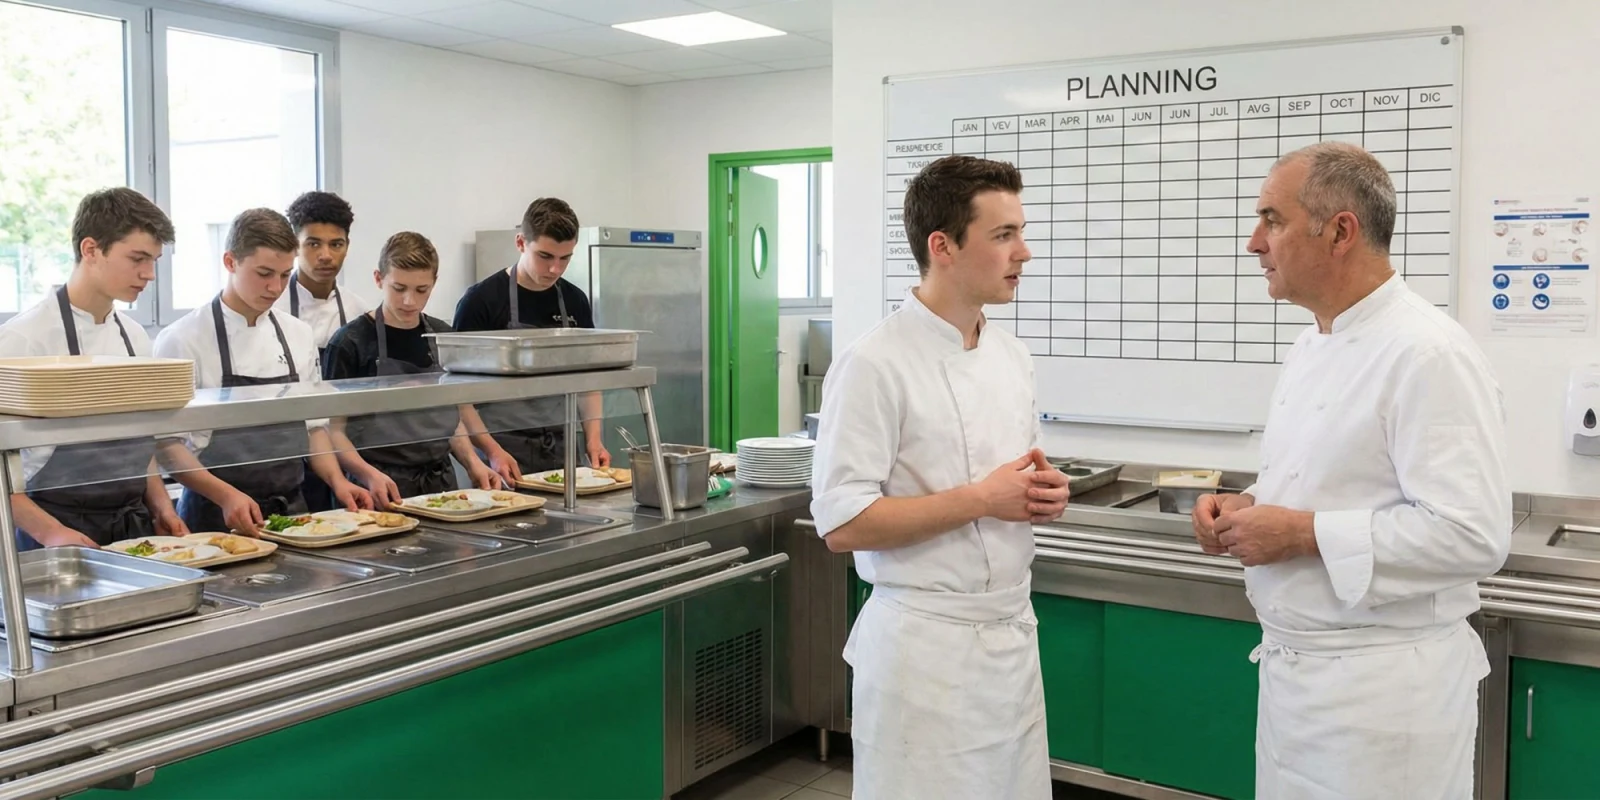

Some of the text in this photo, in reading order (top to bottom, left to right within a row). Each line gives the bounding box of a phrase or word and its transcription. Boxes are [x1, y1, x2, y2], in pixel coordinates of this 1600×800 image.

[1067, 66, 1218, 101] PLANNING
[960, 92, 1441, 133] JAN VEV MAR APR MAI JUN JUN JUL AVG SEP OCT NOV DIC
